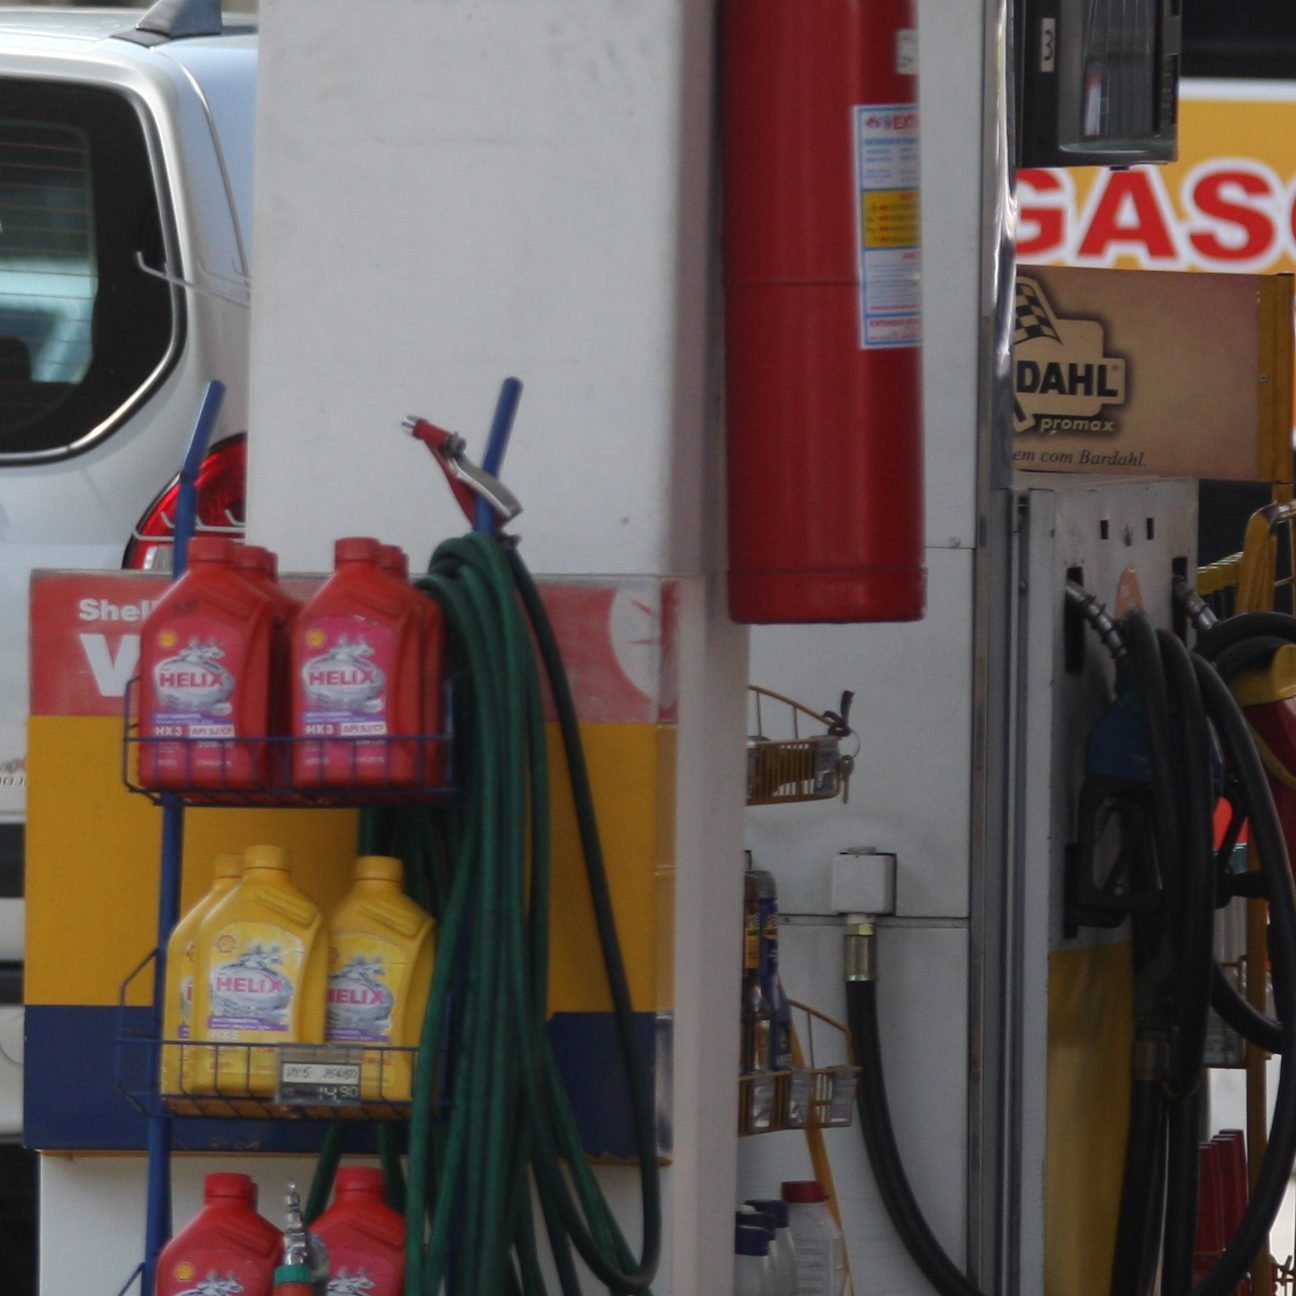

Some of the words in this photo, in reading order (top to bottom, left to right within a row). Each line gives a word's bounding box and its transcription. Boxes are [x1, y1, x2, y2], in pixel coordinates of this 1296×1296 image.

[1016, 359, 1119, 397] DAHL
[1039, 417, 1116, 434] promax
[1040, 450, 1073, 464] com
[1078, 449, 1148, 468] Bardahl.
[160, 672, 225, 687] HELIX
[309, 670, 376, 686] HELIX
[215, 976, 284, 993] HELIX
